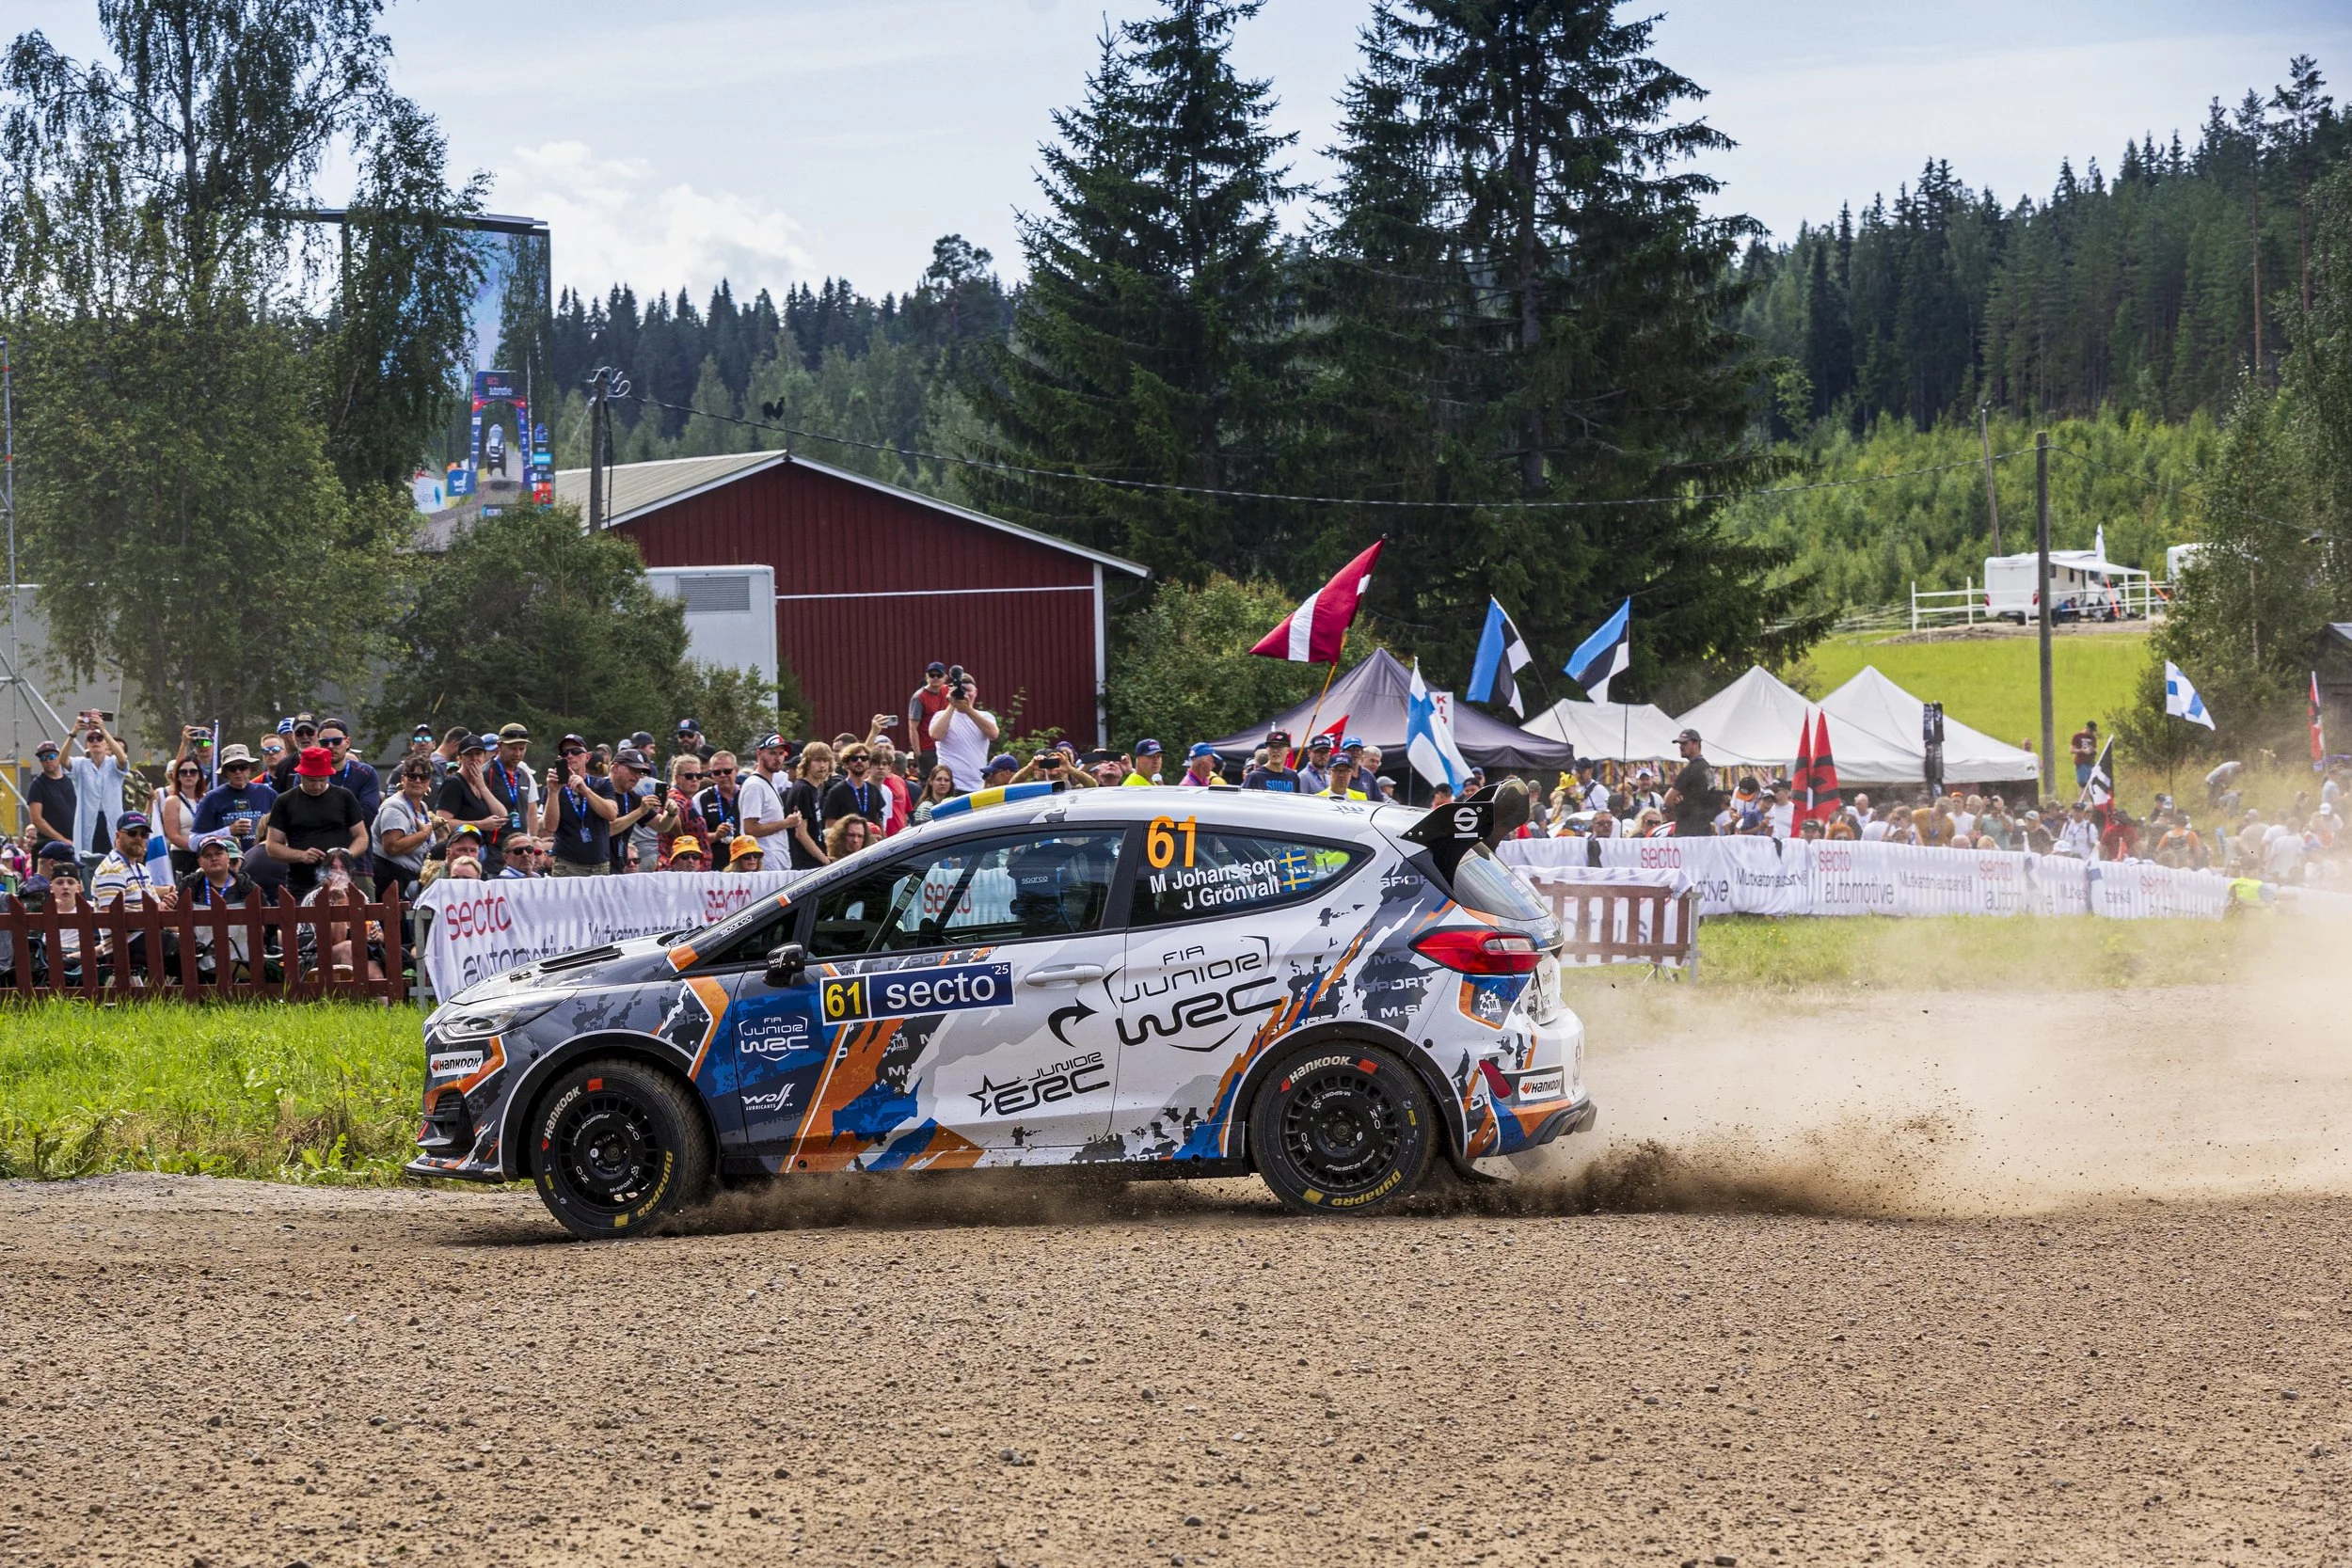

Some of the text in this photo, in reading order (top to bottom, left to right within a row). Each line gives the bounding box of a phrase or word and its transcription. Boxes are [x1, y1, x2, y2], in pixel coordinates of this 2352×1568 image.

[1147, 815, 1197, 869] 61
[1641, 847, 1681, 870] secto
[1819, 850, 1851, 872] secto
[1979, 860, 2013, 882] secto
[1021, 875, 1049, 885] sparco
[1150, 858, 1277, 894] M Johansson
[1825, 876, 1894, 905] automotive
[705, 883, 752, 923] secto
[923, 881, 972, 914] seo
[1183, 875, 1280, 910] J Grönvall
[445, 890, 512, 942] secto
[720, 915, 753, 938] sparco
[1162, 945, 1205, 966] FIA
[1120, 952, 1263, 1004] JUNIOR
[826, 972, 996, 1018] 61 secto
[1115, 975, 1283, 1047] WRC
[740, 1035, 810, 1053] WRC
[743, 1023, 803, 1037] JUNIOR
[1027, 1052, 1104, 1082] JUNIOR
[740, 1084, 795, 1112] wolf
[993, 1063, 1111, 1117] ERC
